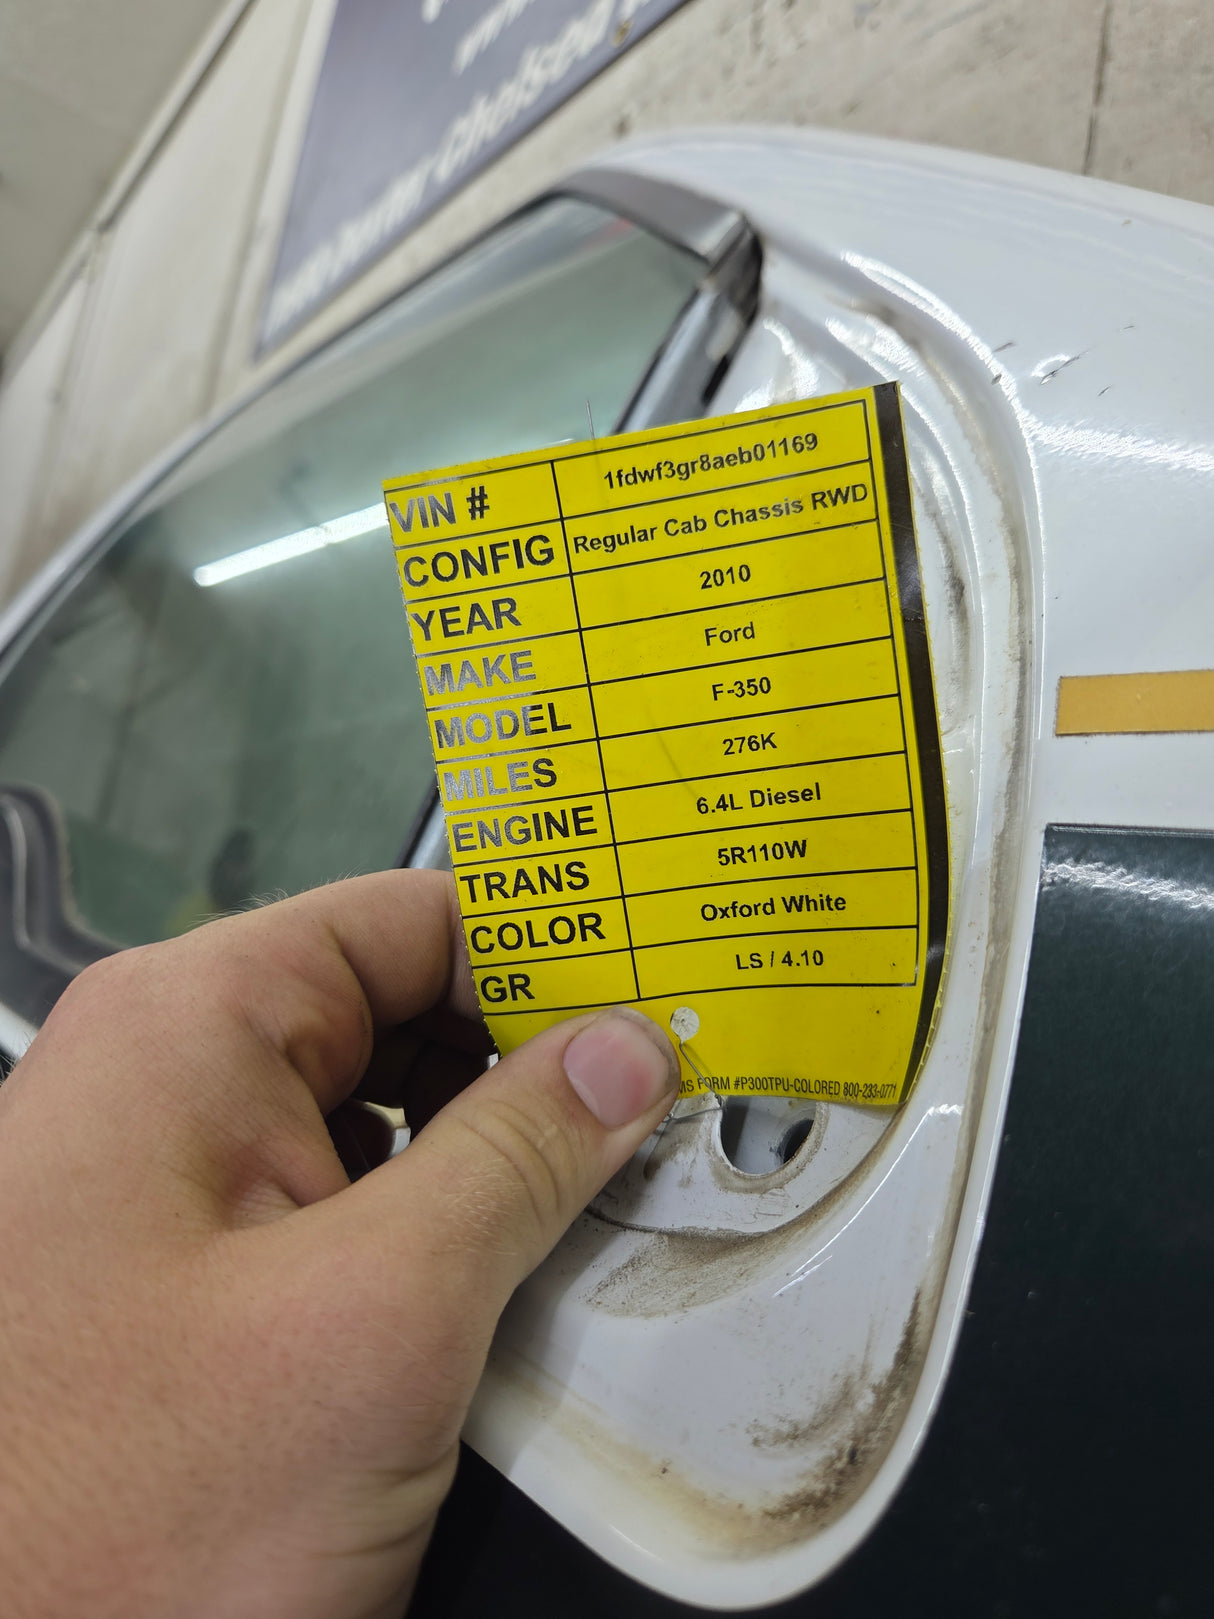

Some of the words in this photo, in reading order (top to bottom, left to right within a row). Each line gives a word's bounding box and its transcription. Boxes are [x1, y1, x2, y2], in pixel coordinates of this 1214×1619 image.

[603, 432, 819, 489] 1fdwf3gr8aeb01169
[389, 492, 457, 533] VIN
[466, 485, 490, 521] #
[573, 524, 658, 553] Regular
[664, 515, 707, 537] Cab
[714, 496, 804, 528] Chassis
[811, 483, 868, 511] RWD
[403, 534, 555, 588] CONFIG
[700, 564, 751, 590] 2010
[410, 597, 522, 642] YEAR
[704, 622, 756, 647] Ford
[423, 650, 537, 696] MAKE
[712, 676, 772, 701] F-350
[434, 702, 572, 749] MODEL
[723, 732, 777, 755] 276K
[443, 758, 557, 802] MILES
[696, 794, 743, 815] 6.4L
[750, 782, 821, 808] Diesel
[452, 805, 597, 852] ENGINE
[717, 840, 808, 866] 5R110W
[459, 861, 590, 903] TRANS
[701, 898, 776, 921] Oxford
[782, 894, 847, 914] White
[470, 912, 606, 954] COLOR
[736, 952, 764, 970] LS
[770, 951, 775, 968] /
[781, 950, 824, 967] 4.10
[480, 973, 535, 1003] GR
[697, 1076, 731, 1090] FORM
[733, 1076, 840, 1096] #P300TPU-COLORED
